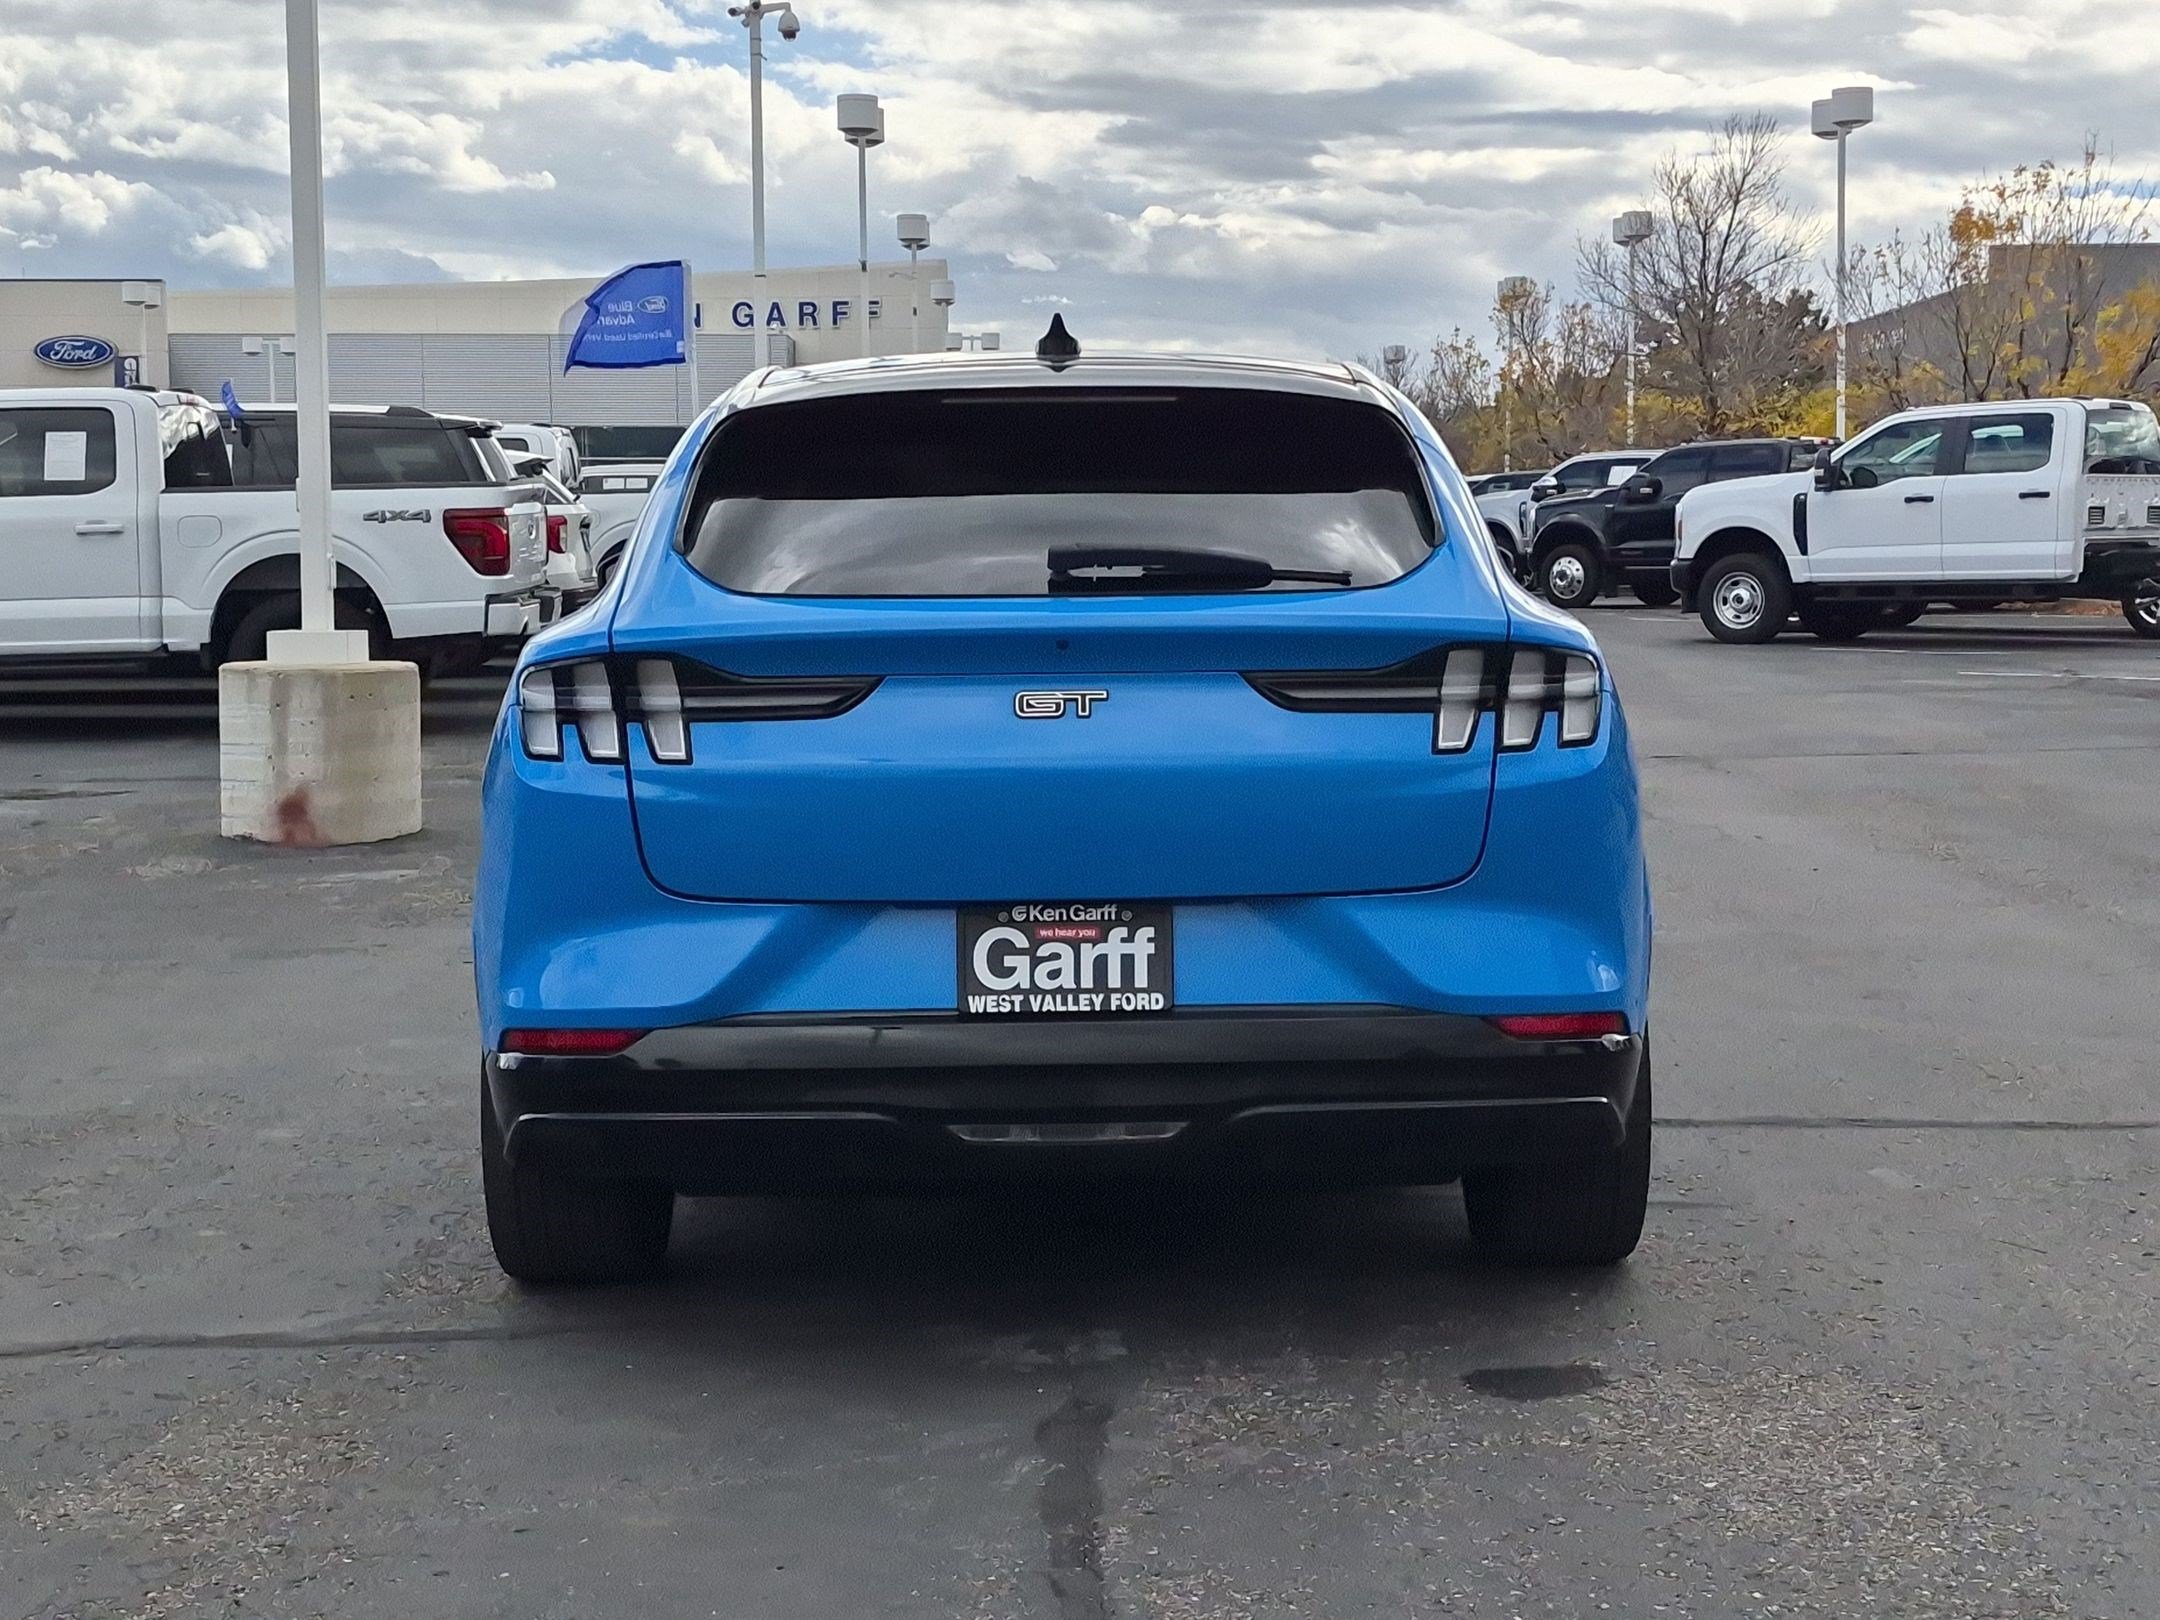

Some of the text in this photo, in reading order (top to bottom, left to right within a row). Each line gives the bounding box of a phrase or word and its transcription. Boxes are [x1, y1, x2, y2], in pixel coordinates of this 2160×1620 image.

[50, 341, 97, 360] Ford
[1015, 689, 1108, 718] GT
[1029, 904, 1118, 921] Ken Garff
[1039, 928, 1096, 938] we hear you
[973, 926, 1155, 991] Garff
[967, 992, 1164, 1013] WEST VALLEY FORD
